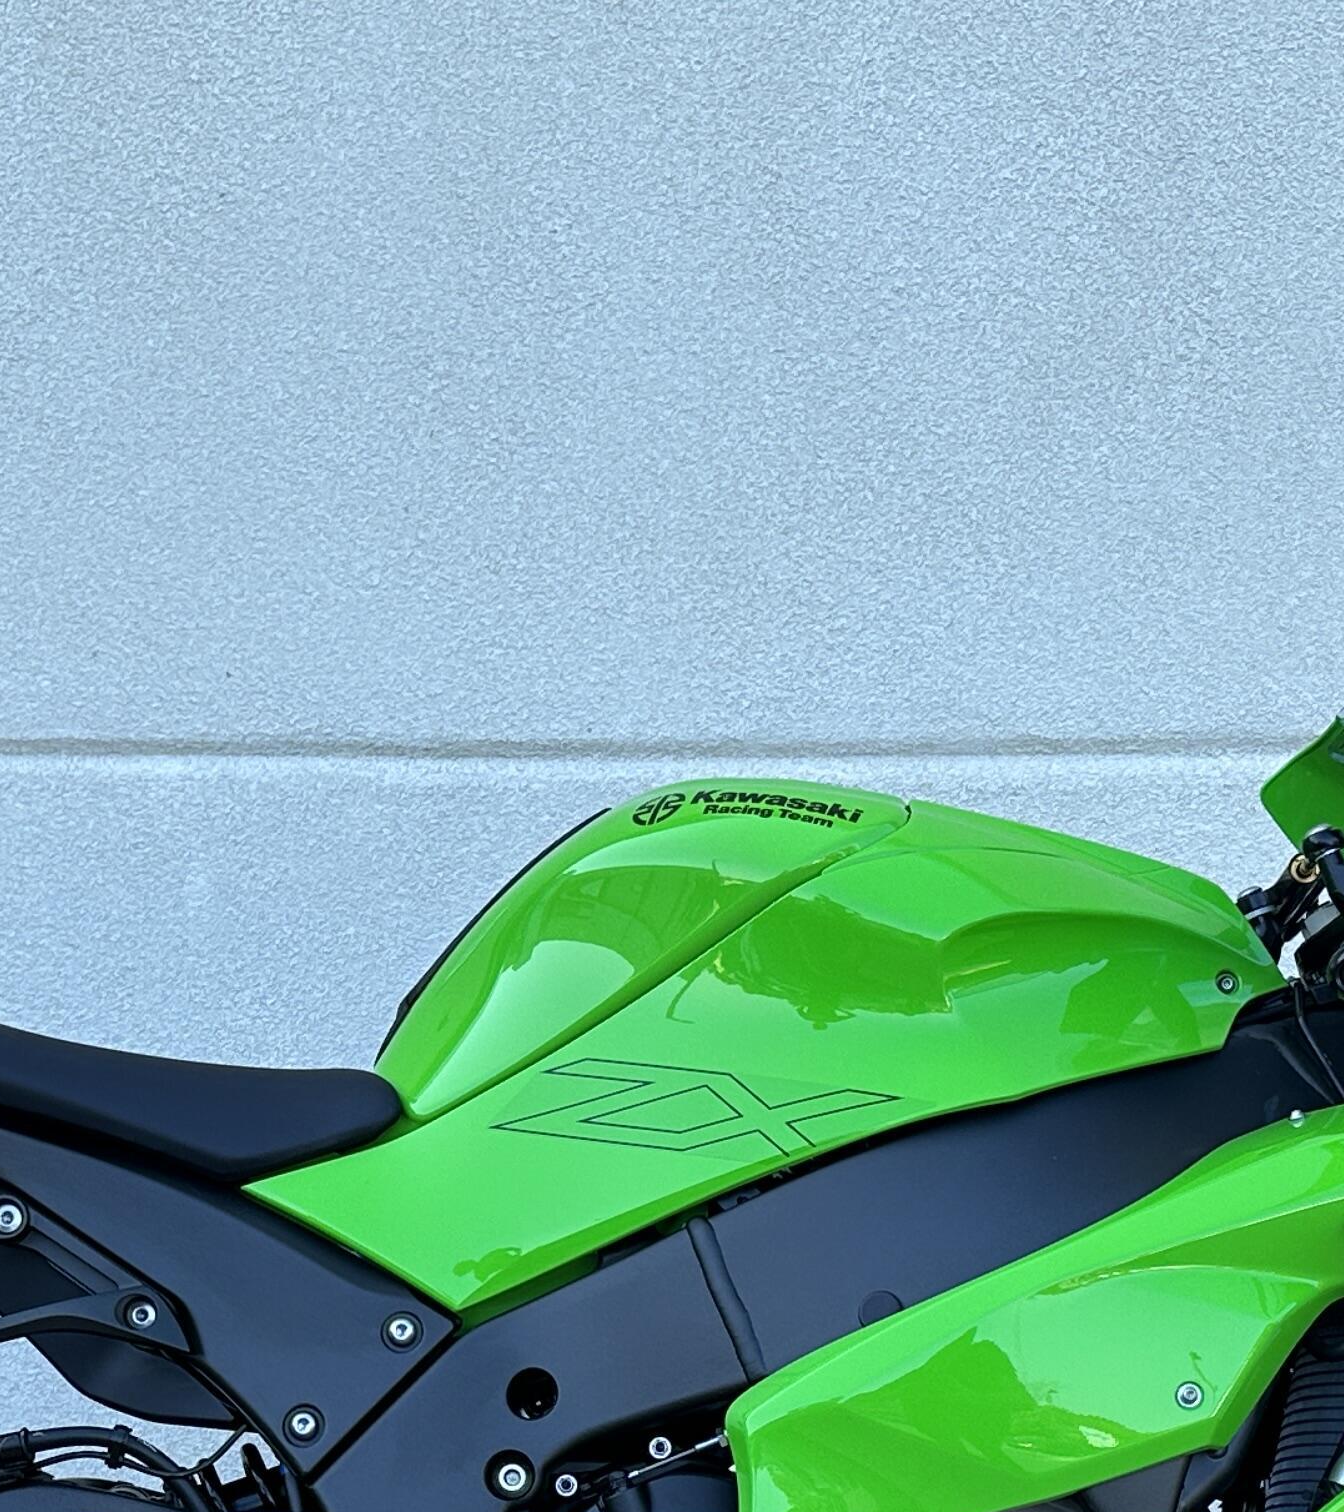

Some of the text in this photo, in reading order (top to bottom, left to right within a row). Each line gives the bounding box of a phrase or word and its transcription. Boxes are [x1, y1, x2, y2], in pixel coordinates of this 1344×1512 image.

[690, 789, 864, 824] Kawasaki
[703, 804, 834, 829] Racing Team
[488, 1057, 906, 1158] ZX
